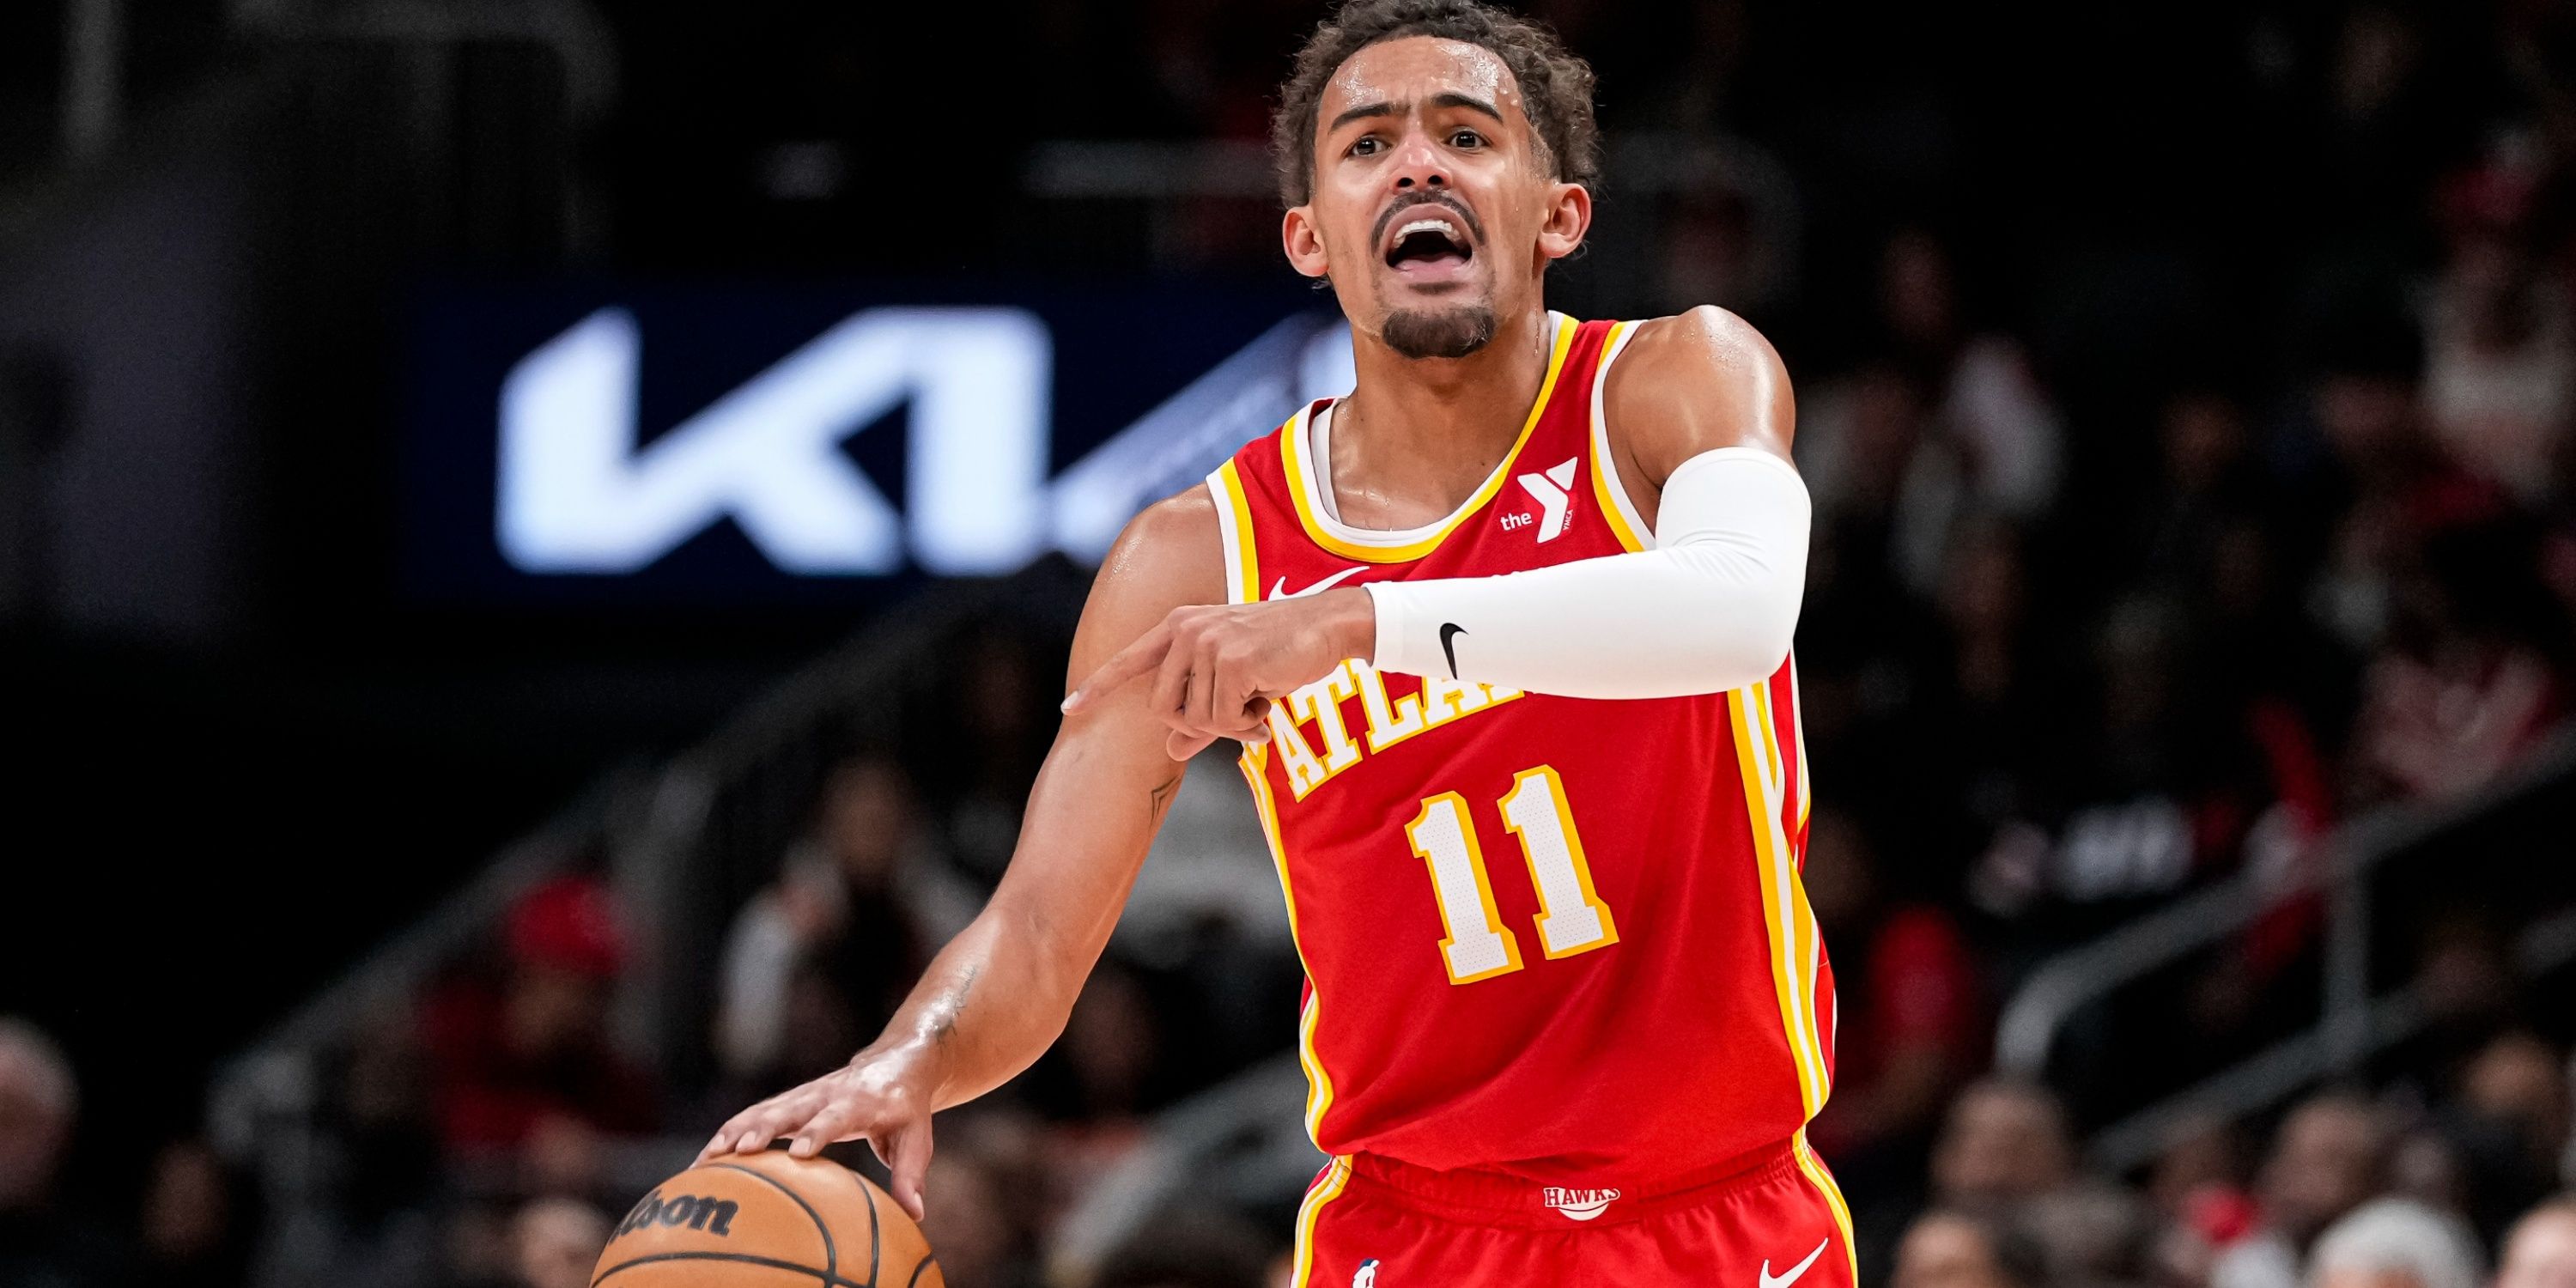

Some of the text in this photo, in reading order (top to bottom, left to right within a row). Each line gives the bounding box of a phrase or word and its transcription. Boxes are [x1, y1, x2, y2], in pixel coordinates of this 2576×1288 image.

[1500, 513, 1533, 531] the
[1563, 509, 1574, 531] YMCA
[1266, 658, 1525, 803] ATLA
[1404, 763, 1619, 985] 11
[609, 1190, 738, 1242] lson
